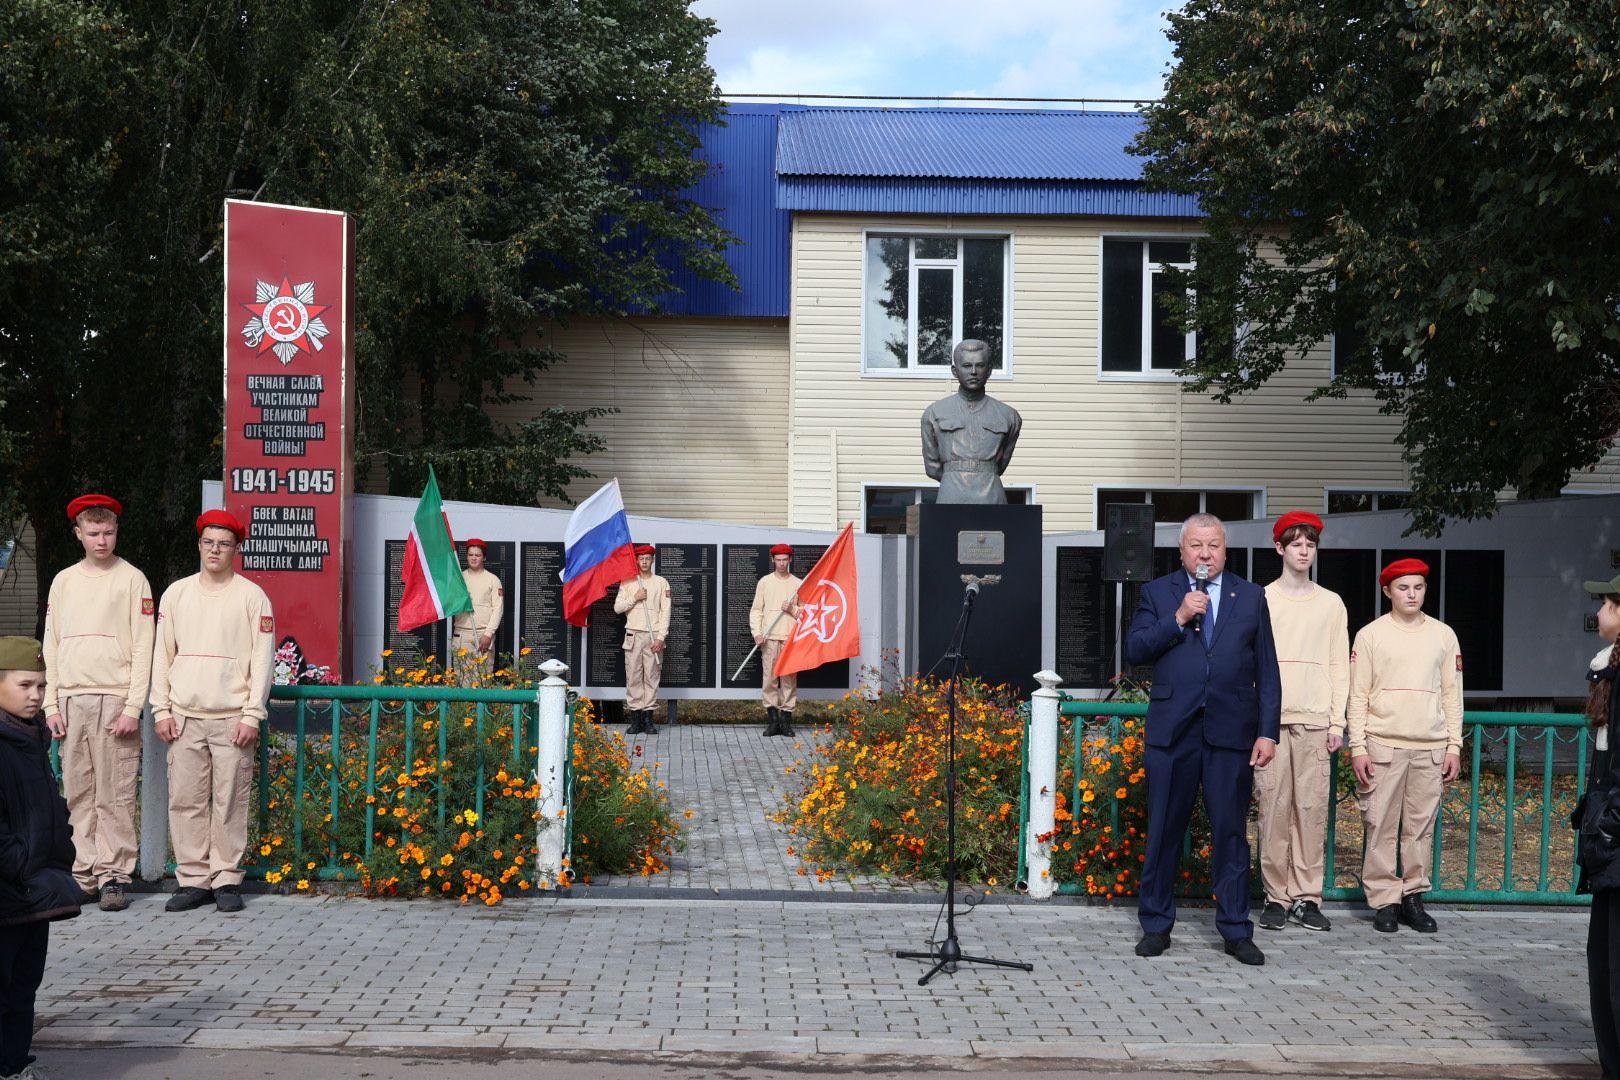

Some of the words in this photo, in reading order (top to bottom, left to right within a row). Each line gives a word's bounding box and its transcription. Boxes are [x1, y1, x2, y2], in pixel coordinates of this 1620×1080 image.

[248, 376, 285, 390] ВЕЧНАЯ
[291, 376, 323, 390] СЛАВА
[252, 392, 317, 406] УЧАСТНИКАМ
[263, 407, 307, 422] ВЕЛИКОЙ
[245, 423, 324, 439] ОТЕЧЕСТВЕННОЙ
[264, 439, 304, 454] ВОЙНЫ!
[232, 469, 334, 493] 1941-1945
[253, 507, 277, 520] БӨЕК
[283, 507, 314, 521] ВАТАН
[251, 523, 316, 537] СУГЫШЫНДА
[244, 555, 293, 571] МӘҢГЕЛЕК
[298, 556, 321, 569] ДАН!
